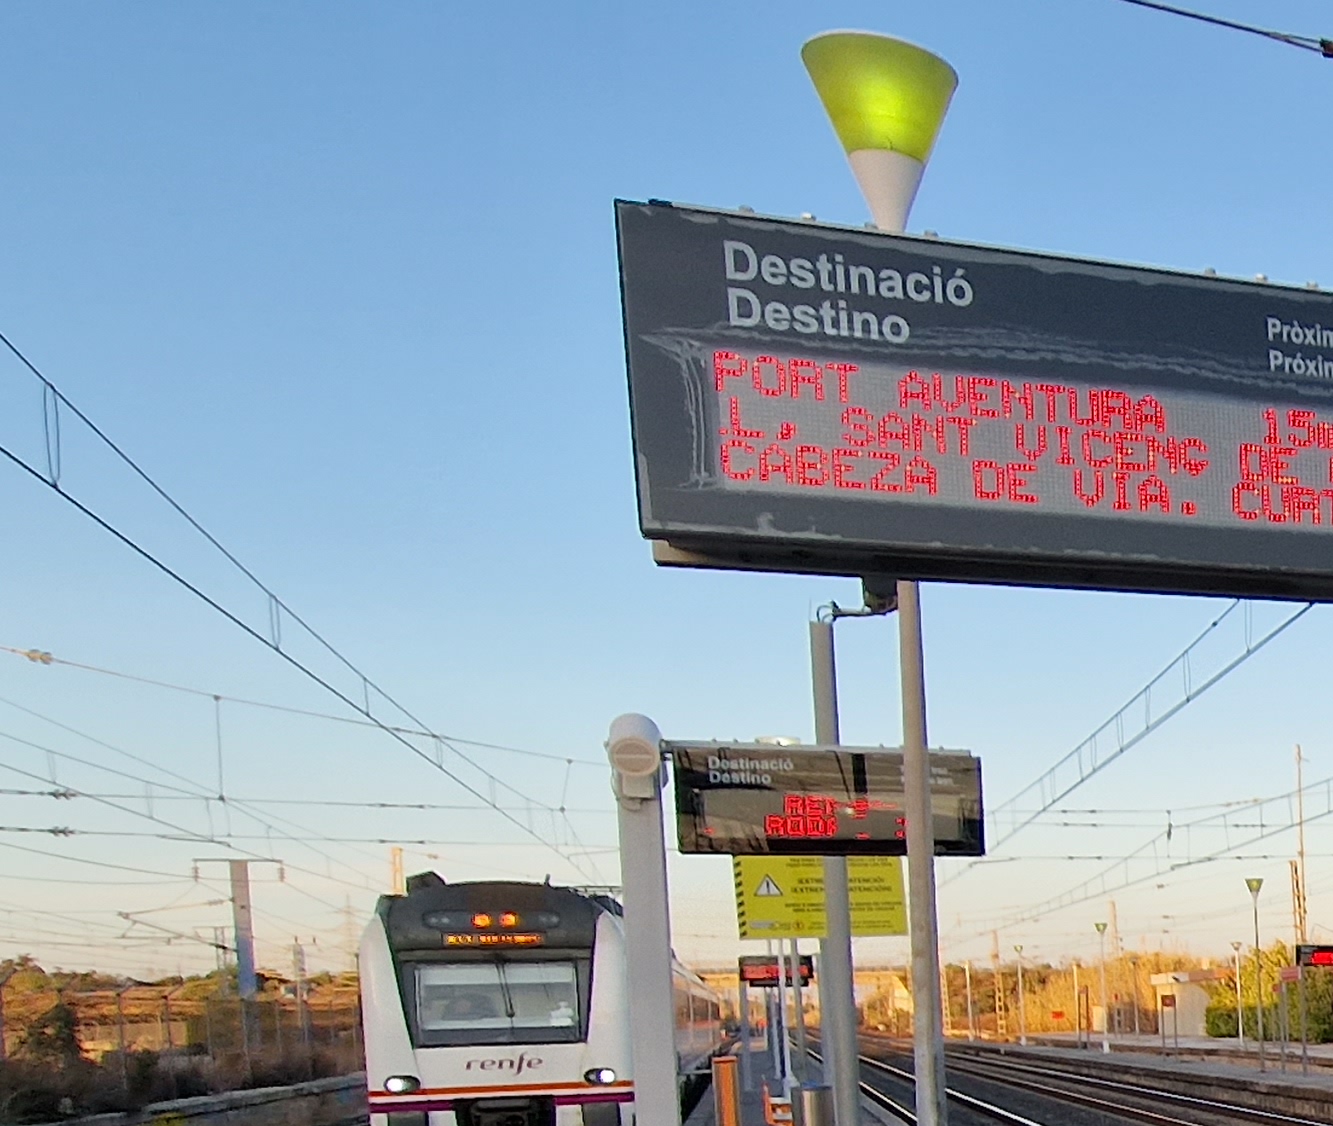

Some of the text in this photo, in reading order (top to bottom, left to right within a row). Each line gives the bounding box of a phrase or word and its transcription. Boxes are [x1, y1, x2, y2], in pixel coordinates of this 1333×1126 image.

[723, 239, 974, 307] Destinació
[726, 286, 911, 344] Destino
[713, 350, 860, 403] PORT
[897, 369, 1167, 433] AVENTURA
[720, 438, 938, 496] CABEZA
[972, 459, 1040, 505] DE
[841, 406, 979, 457] SANT
[1239, 442, 1299, 485] DE
[708, 755, 794, 771] Destinació
[709, 770, 772, 785] Destino
[465, 1051, 544, 1077] renfe
